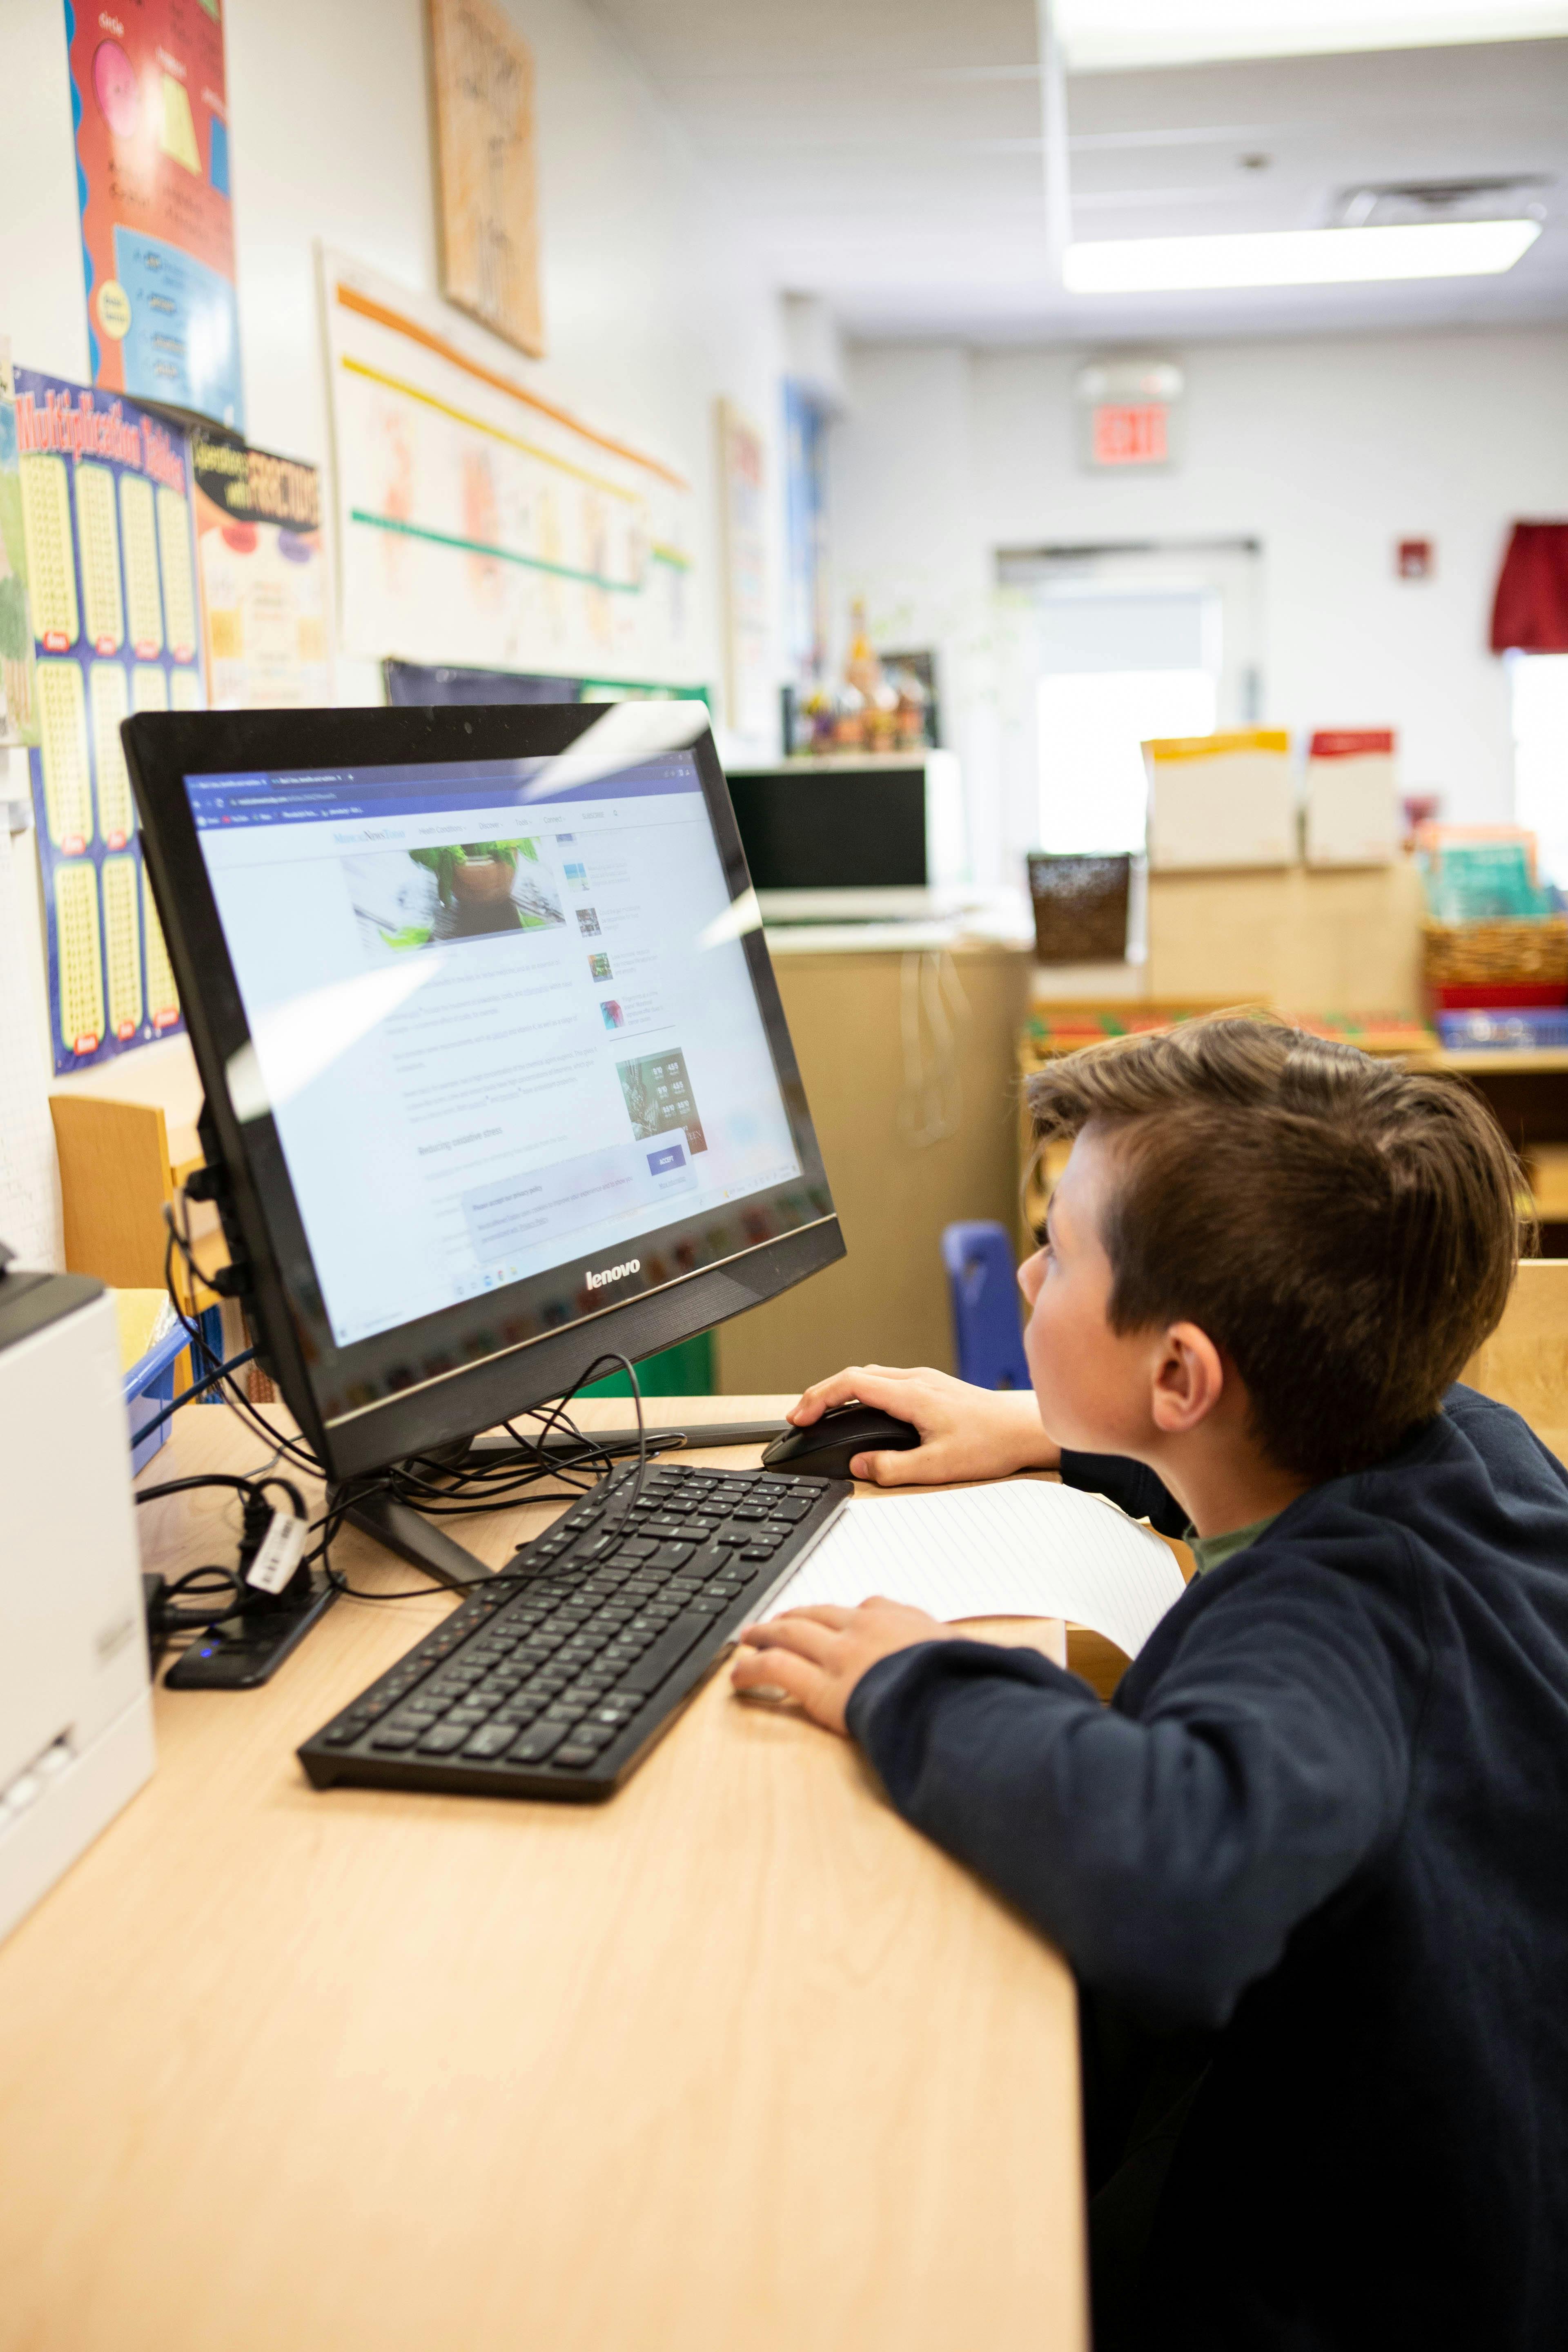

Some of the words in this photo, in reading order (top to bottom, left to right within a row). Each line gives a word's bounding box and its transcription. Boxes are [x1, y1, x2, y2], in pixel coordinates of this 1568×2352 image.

[515, 818, 529, 826] Tools
[543, 815, 562, 824] Connect
[435, 824, 463, 833] Conditions
[478, 820, 500, 829] Discover
[482, 1125, 504, 1141] stress
[659, 1155, 674, 1165] ACCEPT
[512, 1188, 530, 1200] privacy
[529, 1184, 543, 1195] policy
[586, 1259, 640, 1291] lenovo
